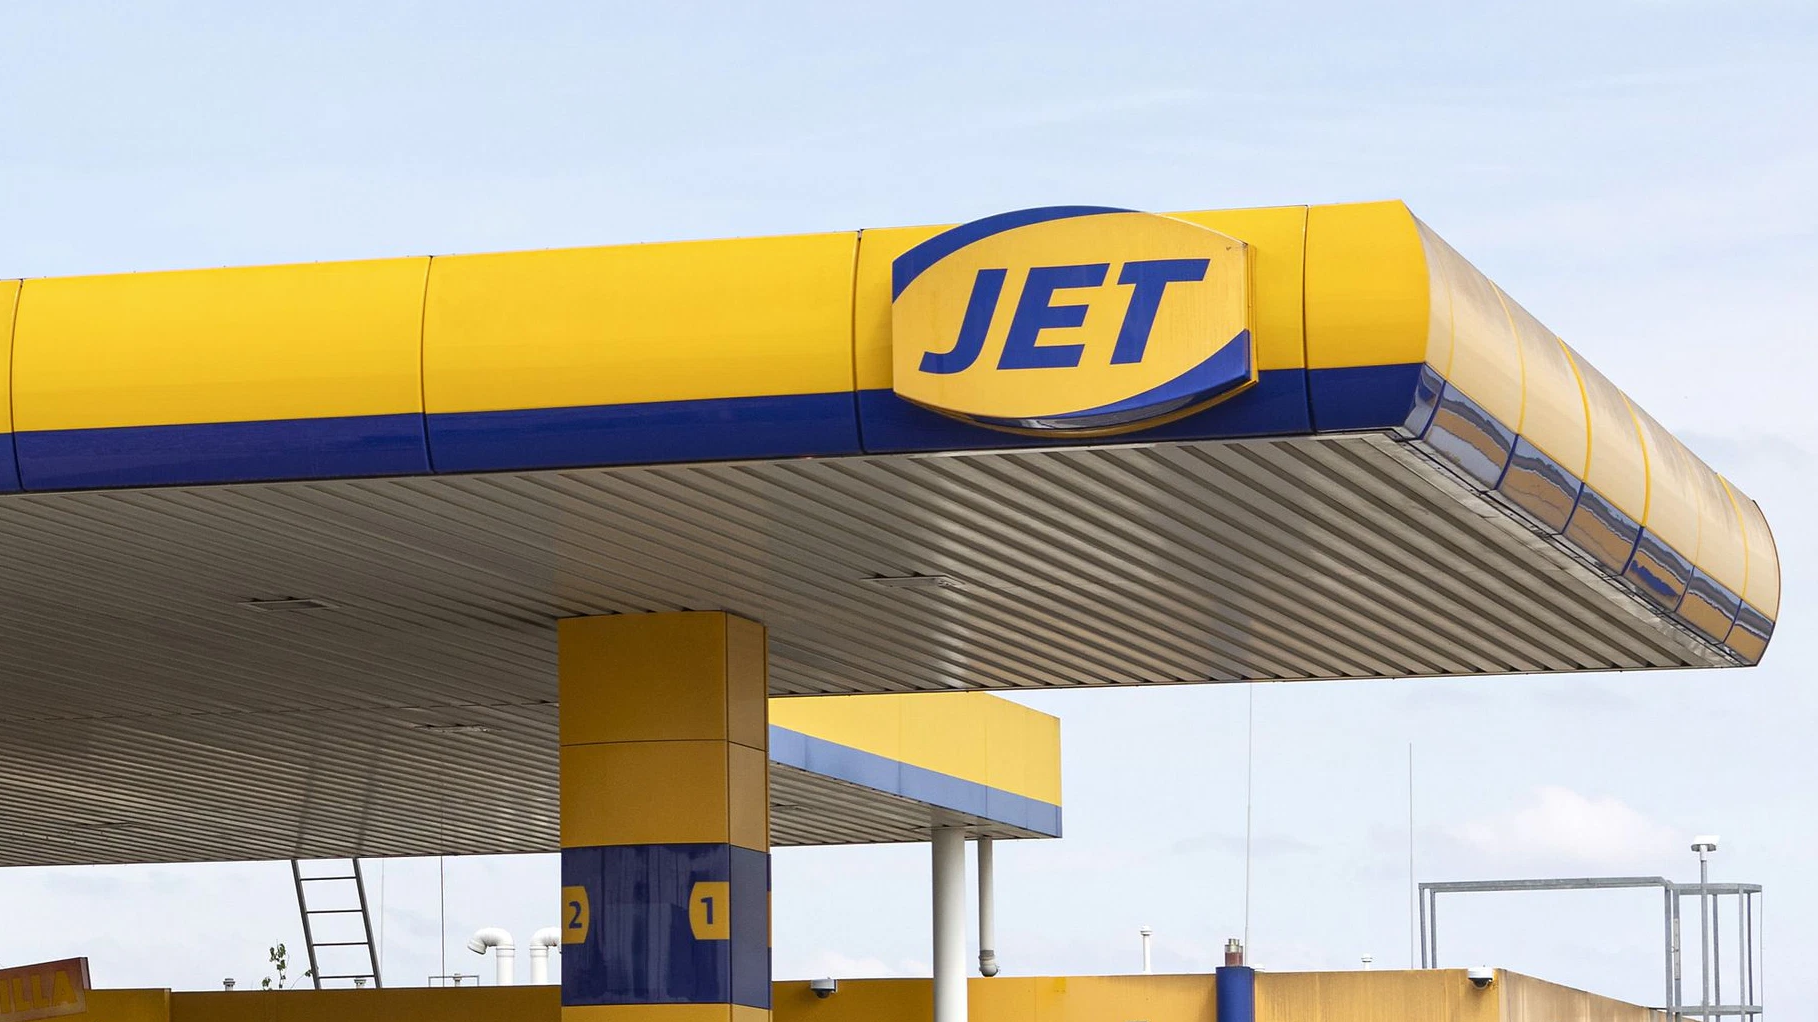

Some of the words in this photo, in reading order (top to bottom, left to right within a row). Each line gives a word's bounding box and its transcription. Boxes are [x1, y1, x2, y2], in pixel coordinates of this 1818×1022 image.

[918, 258, 1211, 375] JET
[568, 900, 582, 929] 2
[700, 897, 713, 925] 1
